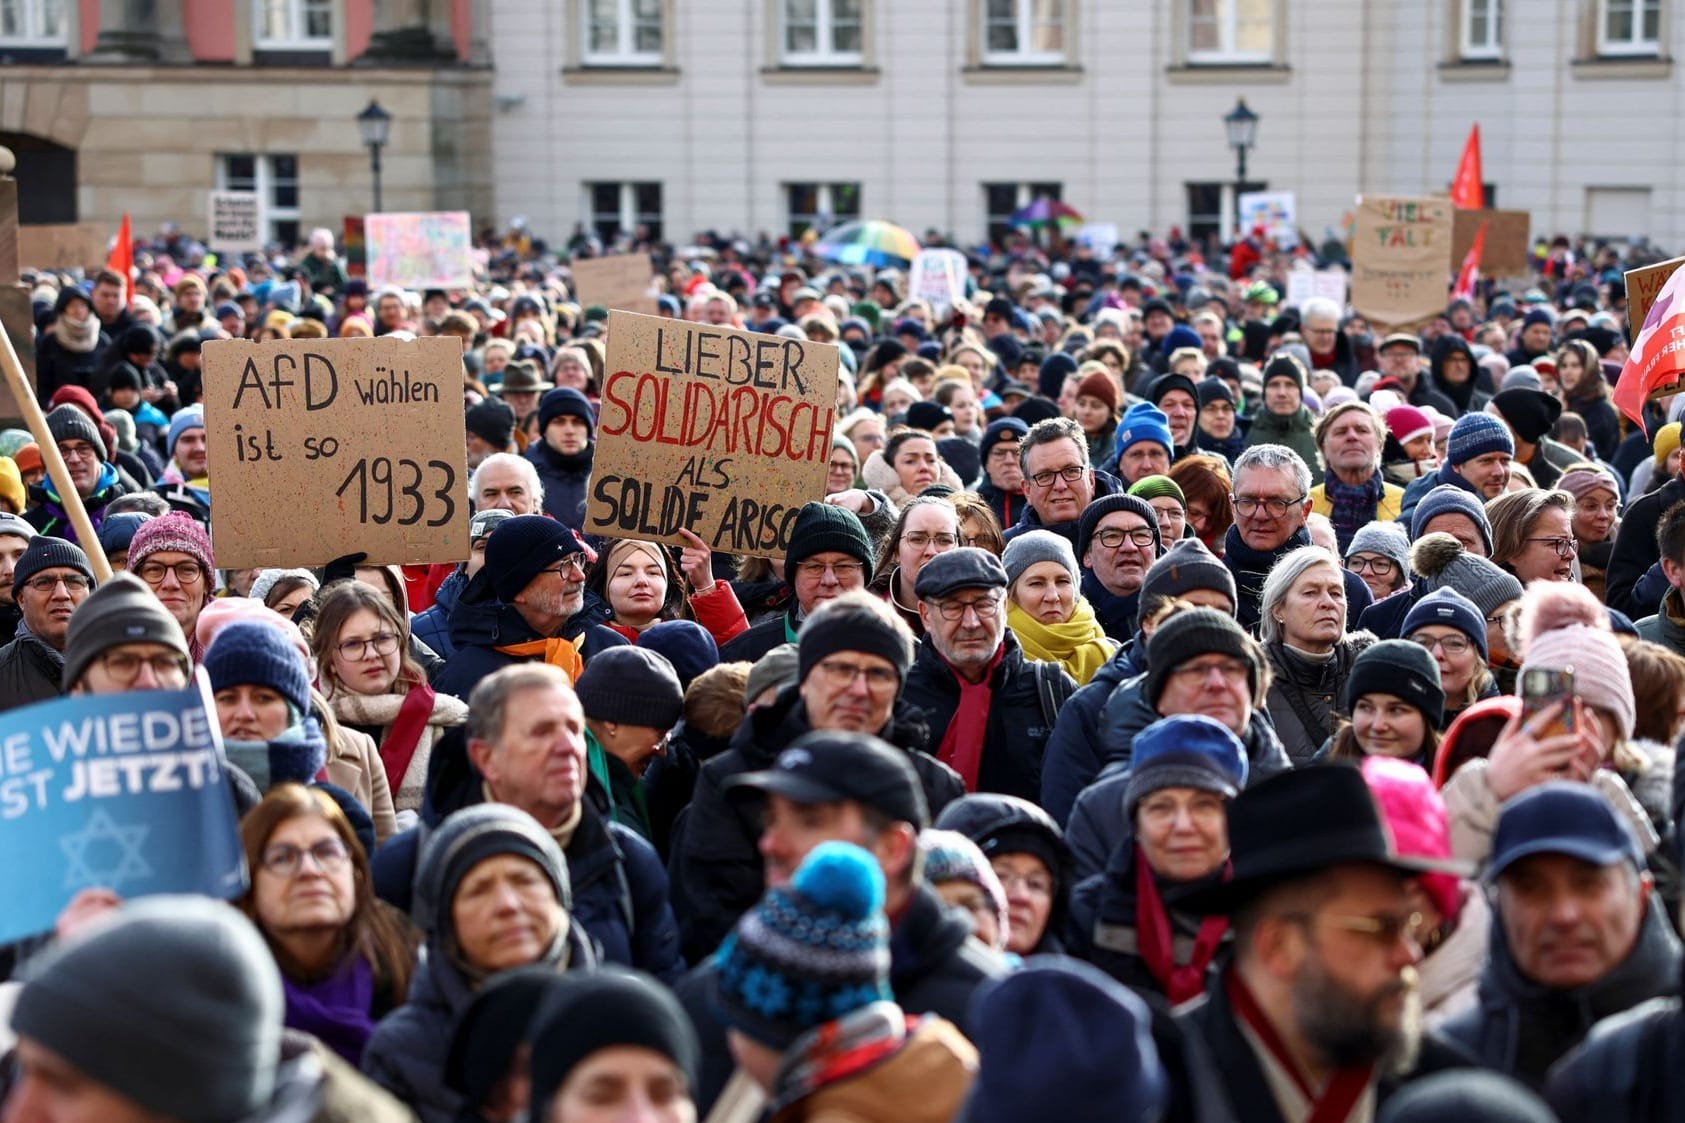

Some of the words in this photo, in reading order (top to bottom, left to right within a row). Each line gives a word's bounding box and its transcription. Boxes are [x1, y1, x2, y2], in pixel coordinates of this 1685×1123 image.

[232, 353, 338, 411] AfD
[354, 367, 439, 406] wählen
[655, 328, 807, 395] LIEBER
[234, 424, 283, 461] ist
[304, 437, 339, 460] so
[602, 371, 833, 463] SOLIDARISCH
[335, 457, 456, 527] 1933
[675, 456, 733, 489] ALS
[592, 475, 709, 537] SOLIDE
[62, 749, 220, 802] JETZT!
